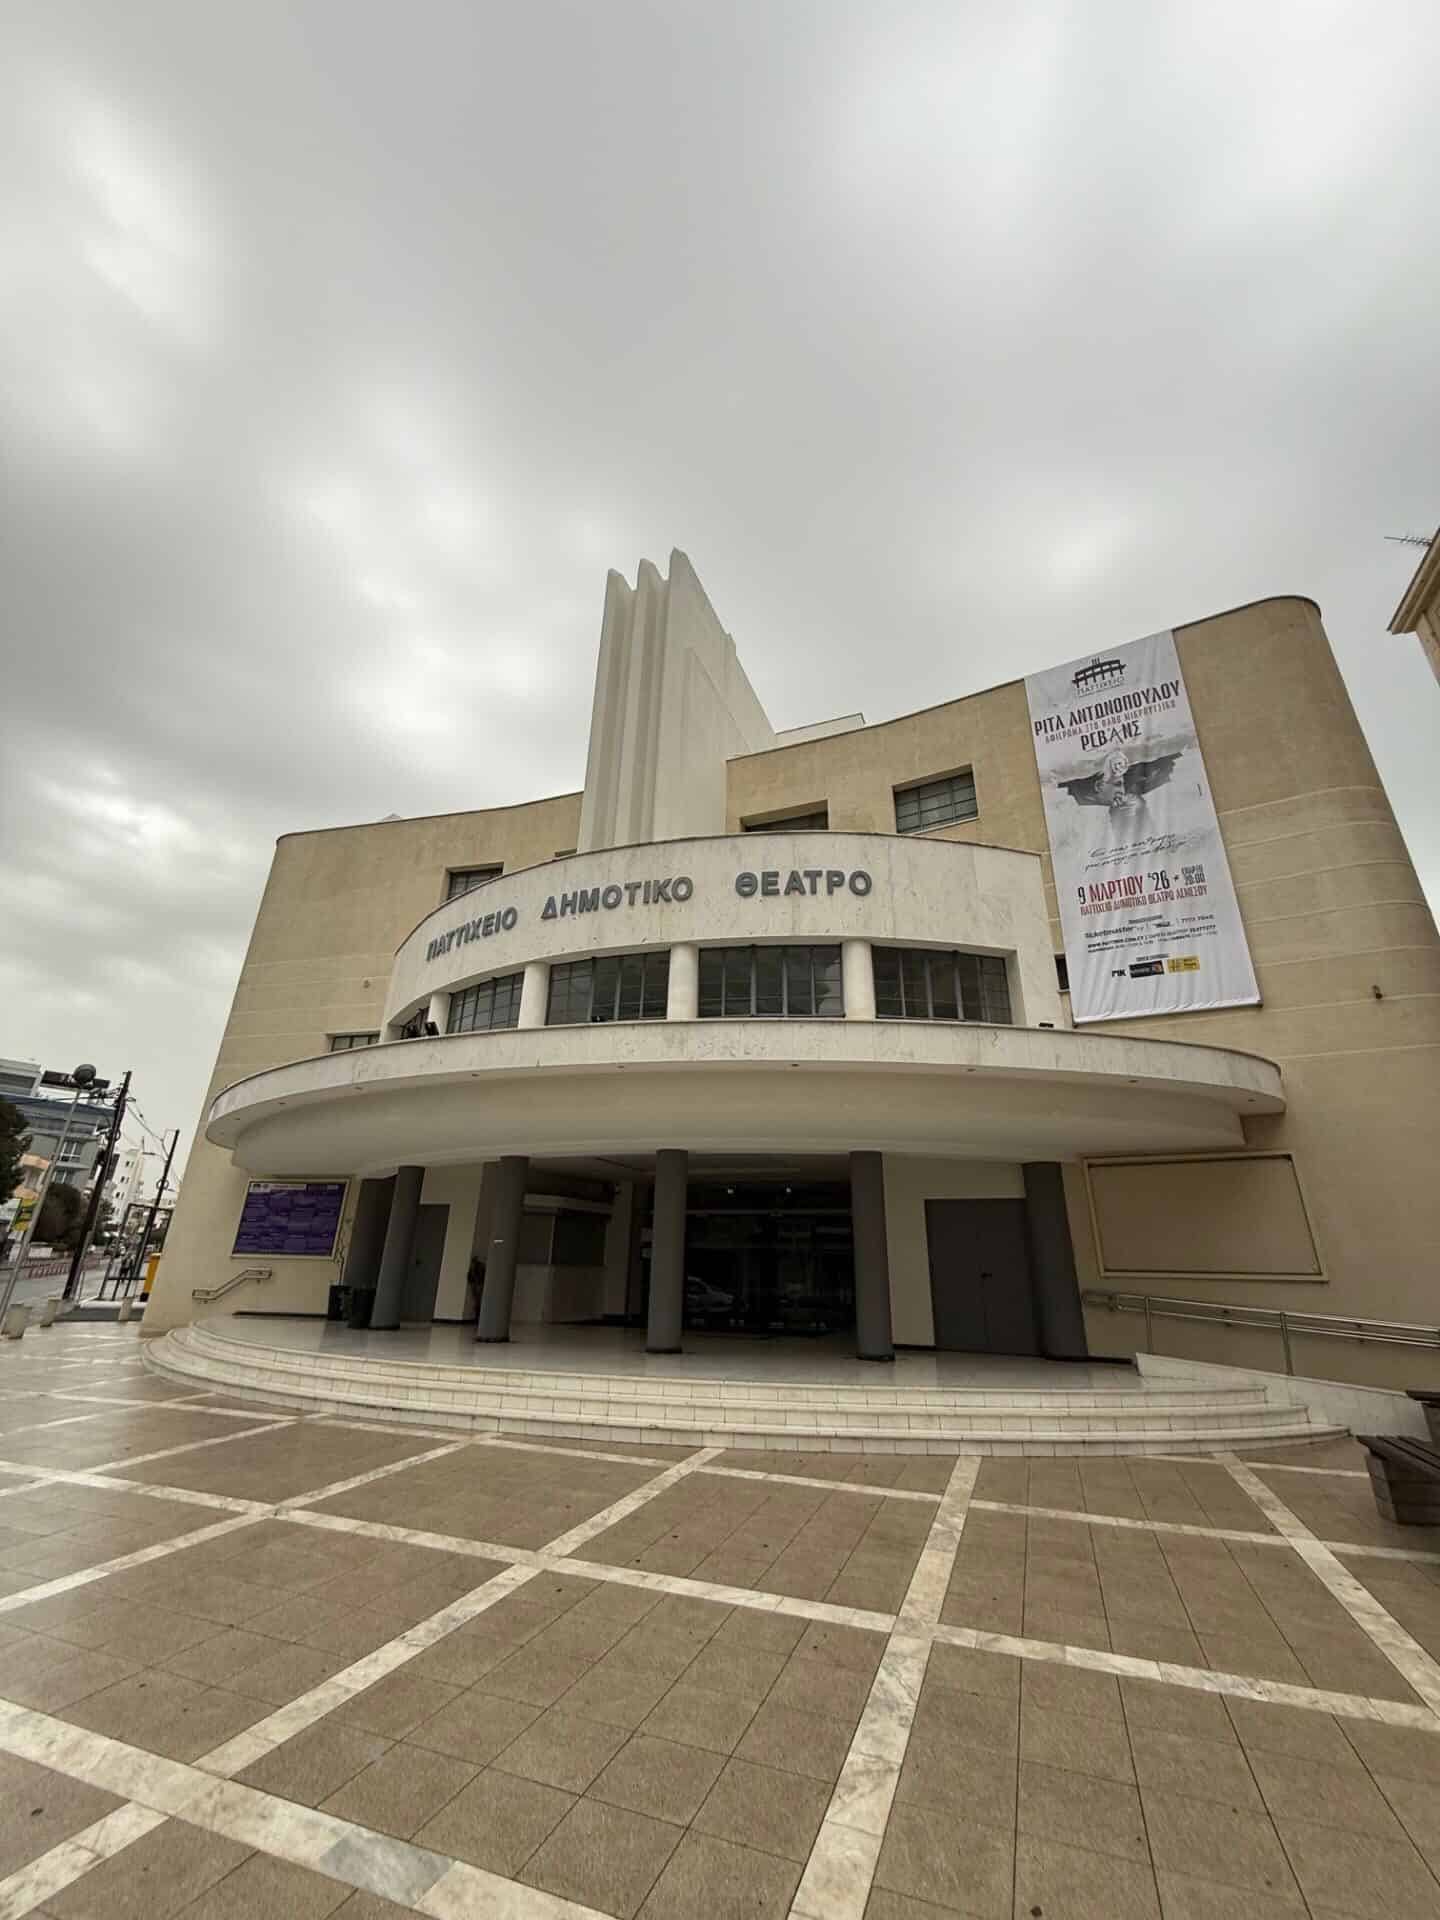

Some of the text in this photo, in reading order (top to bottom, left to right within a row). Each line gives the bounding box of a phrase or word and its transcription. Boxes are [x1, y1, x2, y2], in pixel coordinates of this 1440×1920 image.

[1034, 679, 1181, 737] ΡΙΤΑ ΑΝΤΩΝΟΠΟΥΛΟΥ
[1077, 886, 1087, 905] 9
[1088, 876, 1144, 903] ΜΑΡΤΙΟΥ
[1148, 890, 1175, 905] ΘΕΑΤΡΟ
[425, 870, 873, 962] ΠΑΤΤΙΧΕΙΟ ΔΗΜΟΤΙΚΟ ΘΕΑΤΡΟ
